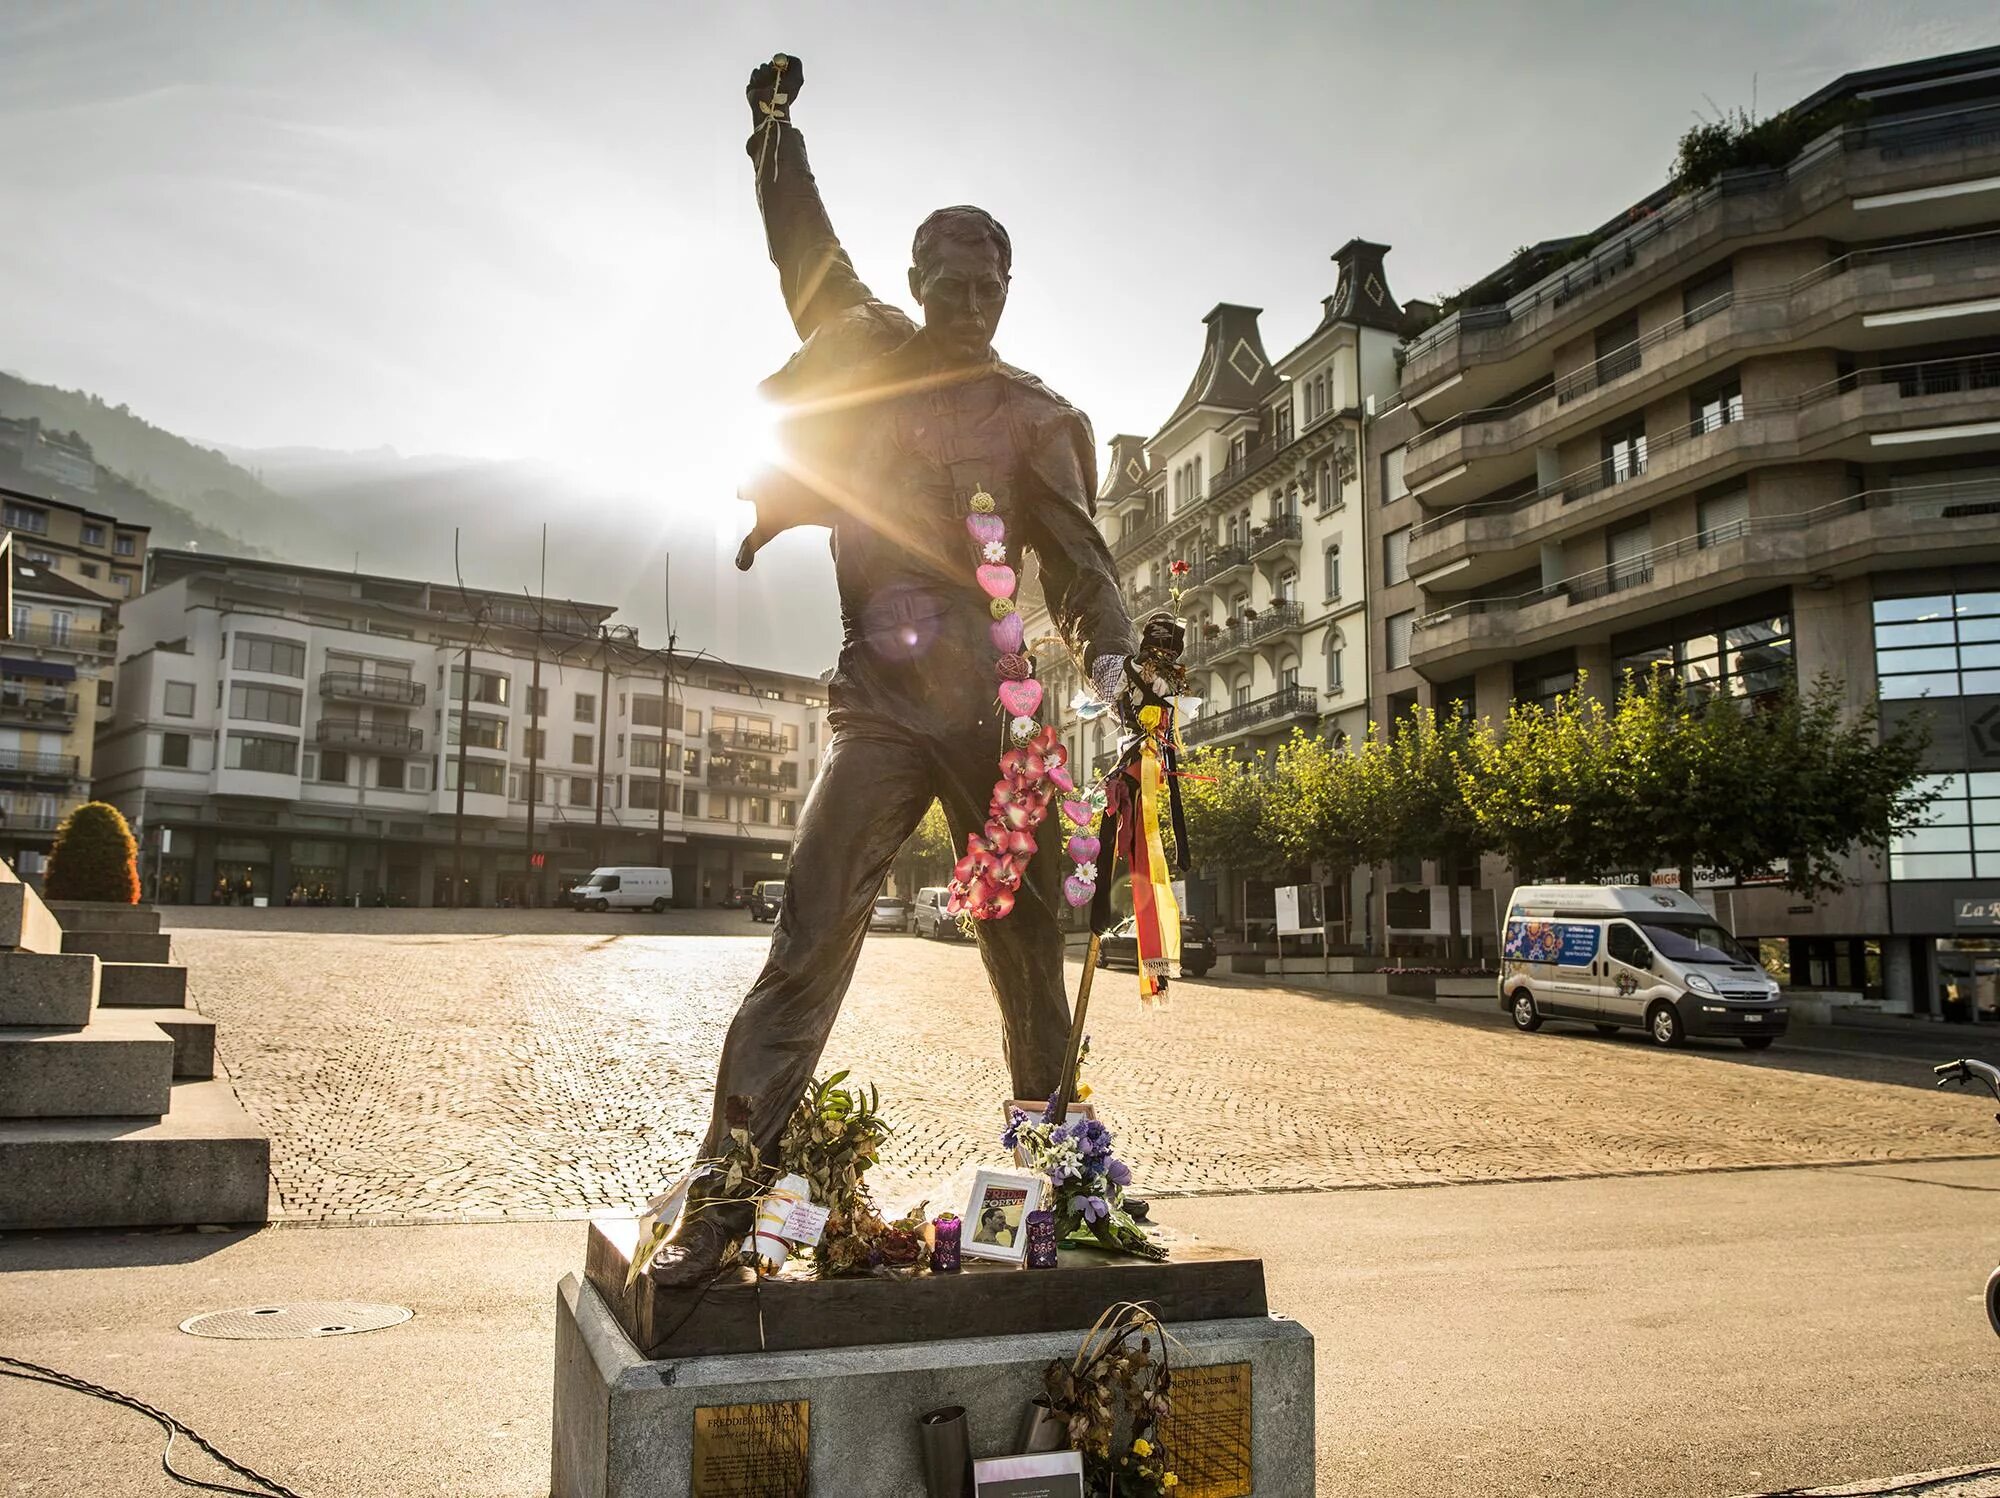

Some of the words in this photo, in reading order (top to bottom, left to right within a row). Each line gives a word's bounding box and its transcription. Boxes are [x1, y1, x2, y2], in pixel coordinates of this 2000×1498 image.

[1960, 902, 1984, 917] La
[1172, 1378, 1201, 1388] REDDIE
[1203, 1375, 1240, 1385] MERCURY
[708, 1416, 748, 1428] FREDDIE
[750, 1413, 795, 1426] MERCURY
